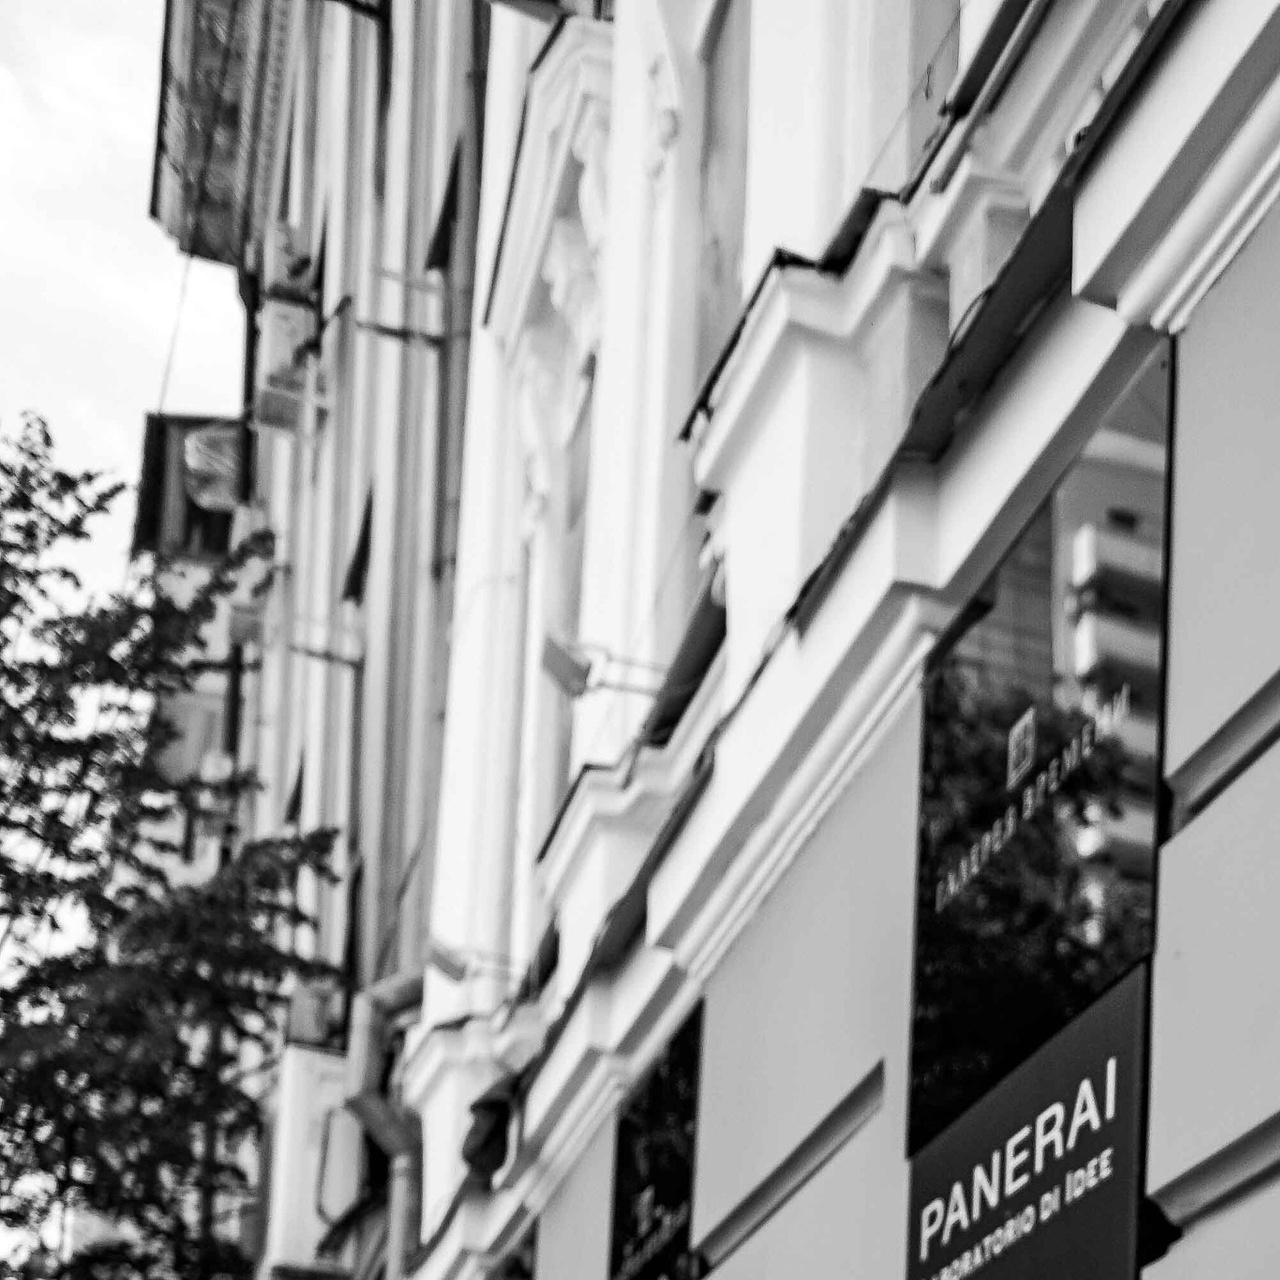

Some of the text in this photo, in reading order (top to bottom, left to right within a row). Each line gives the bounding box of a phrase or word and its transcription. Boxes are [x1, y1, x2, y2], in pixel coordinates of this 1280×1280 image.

[919, 1056, 1117, 1262] PANERAI
[1039, 1184, 1061, 1222] DI
[1065, 1147, 1114, 1204] IDEE
